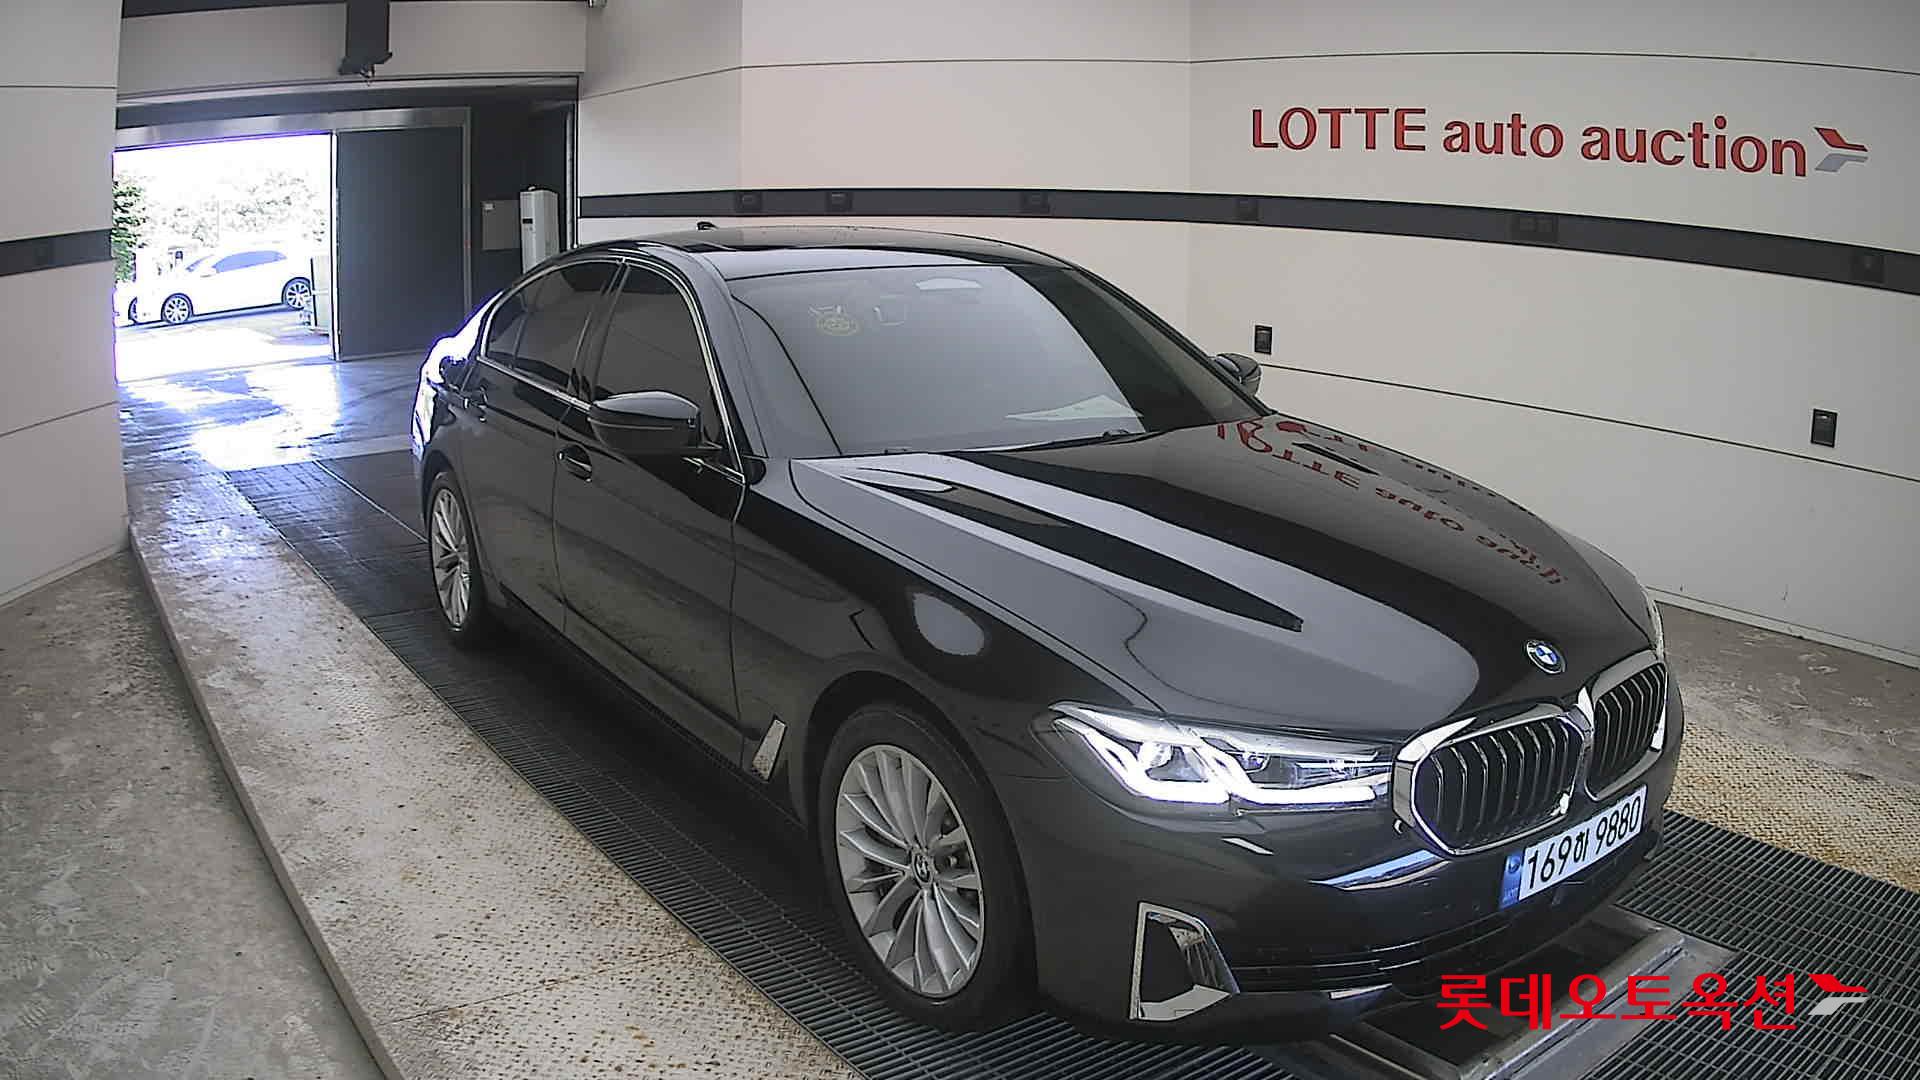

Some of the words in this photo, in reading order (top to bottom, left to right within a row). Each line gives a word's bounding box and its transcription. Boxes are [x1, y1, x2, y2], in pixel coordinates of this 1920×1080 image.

[1251, 107, 1426, 152] LOTTE
[1443, 113, 1564, 158] auto
[1580, 114, 1807, 177] auction
[1527, 828, 1590, 890] 169하
[1595, 795, 1641, 855] 9880
